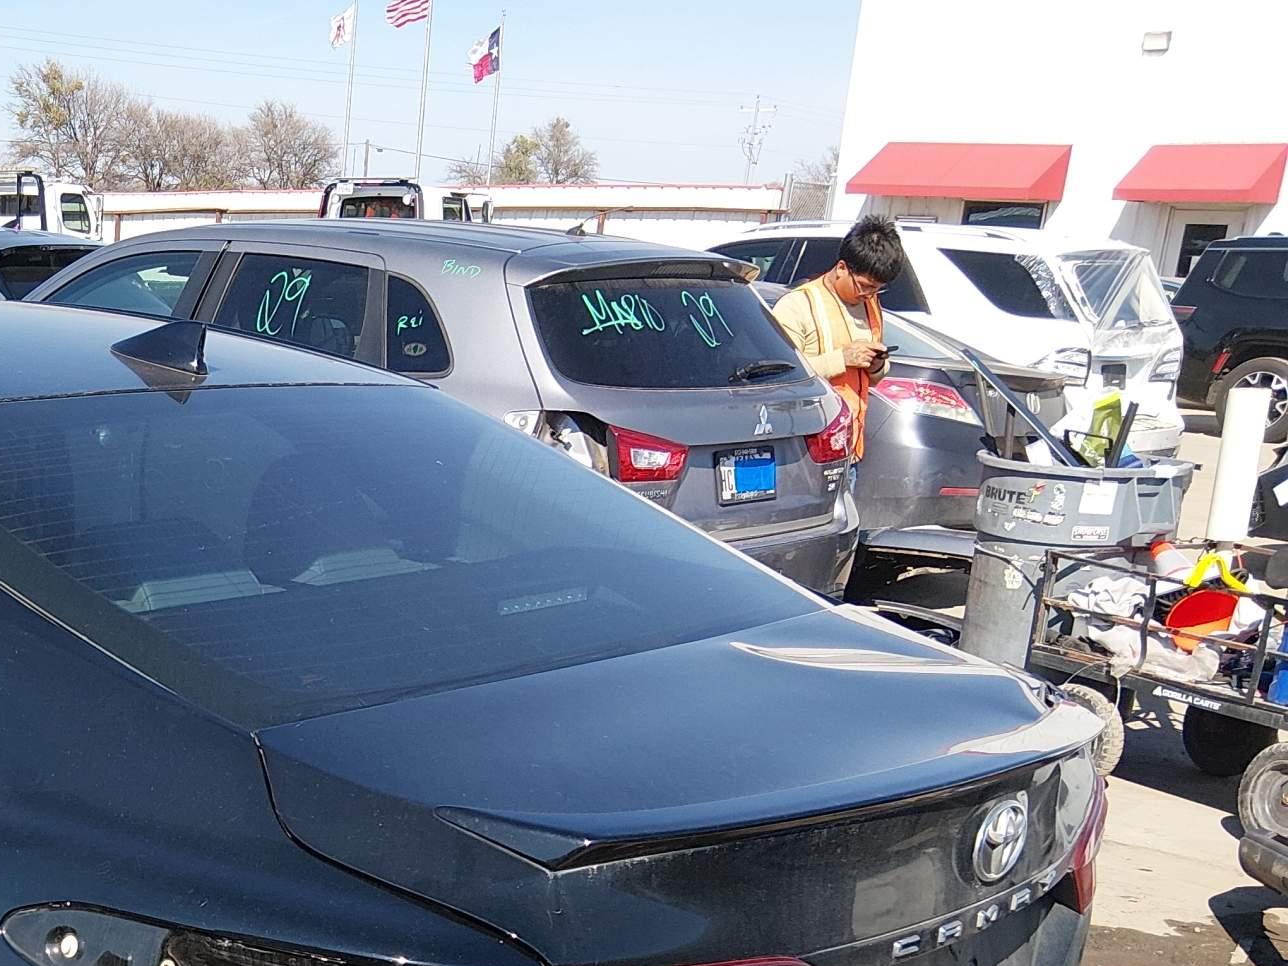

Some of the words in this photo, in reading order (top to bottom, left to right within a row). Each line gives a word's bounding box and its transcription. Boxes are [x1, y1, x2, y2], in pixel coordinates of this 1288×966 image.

[985, 484, 1026, 505] BRUTE
[1162, 688, 1193, 704] GORILLA
[1193, 697, 1222, 711] CARTS
[892, 869, 1057, 959] CAMRY
